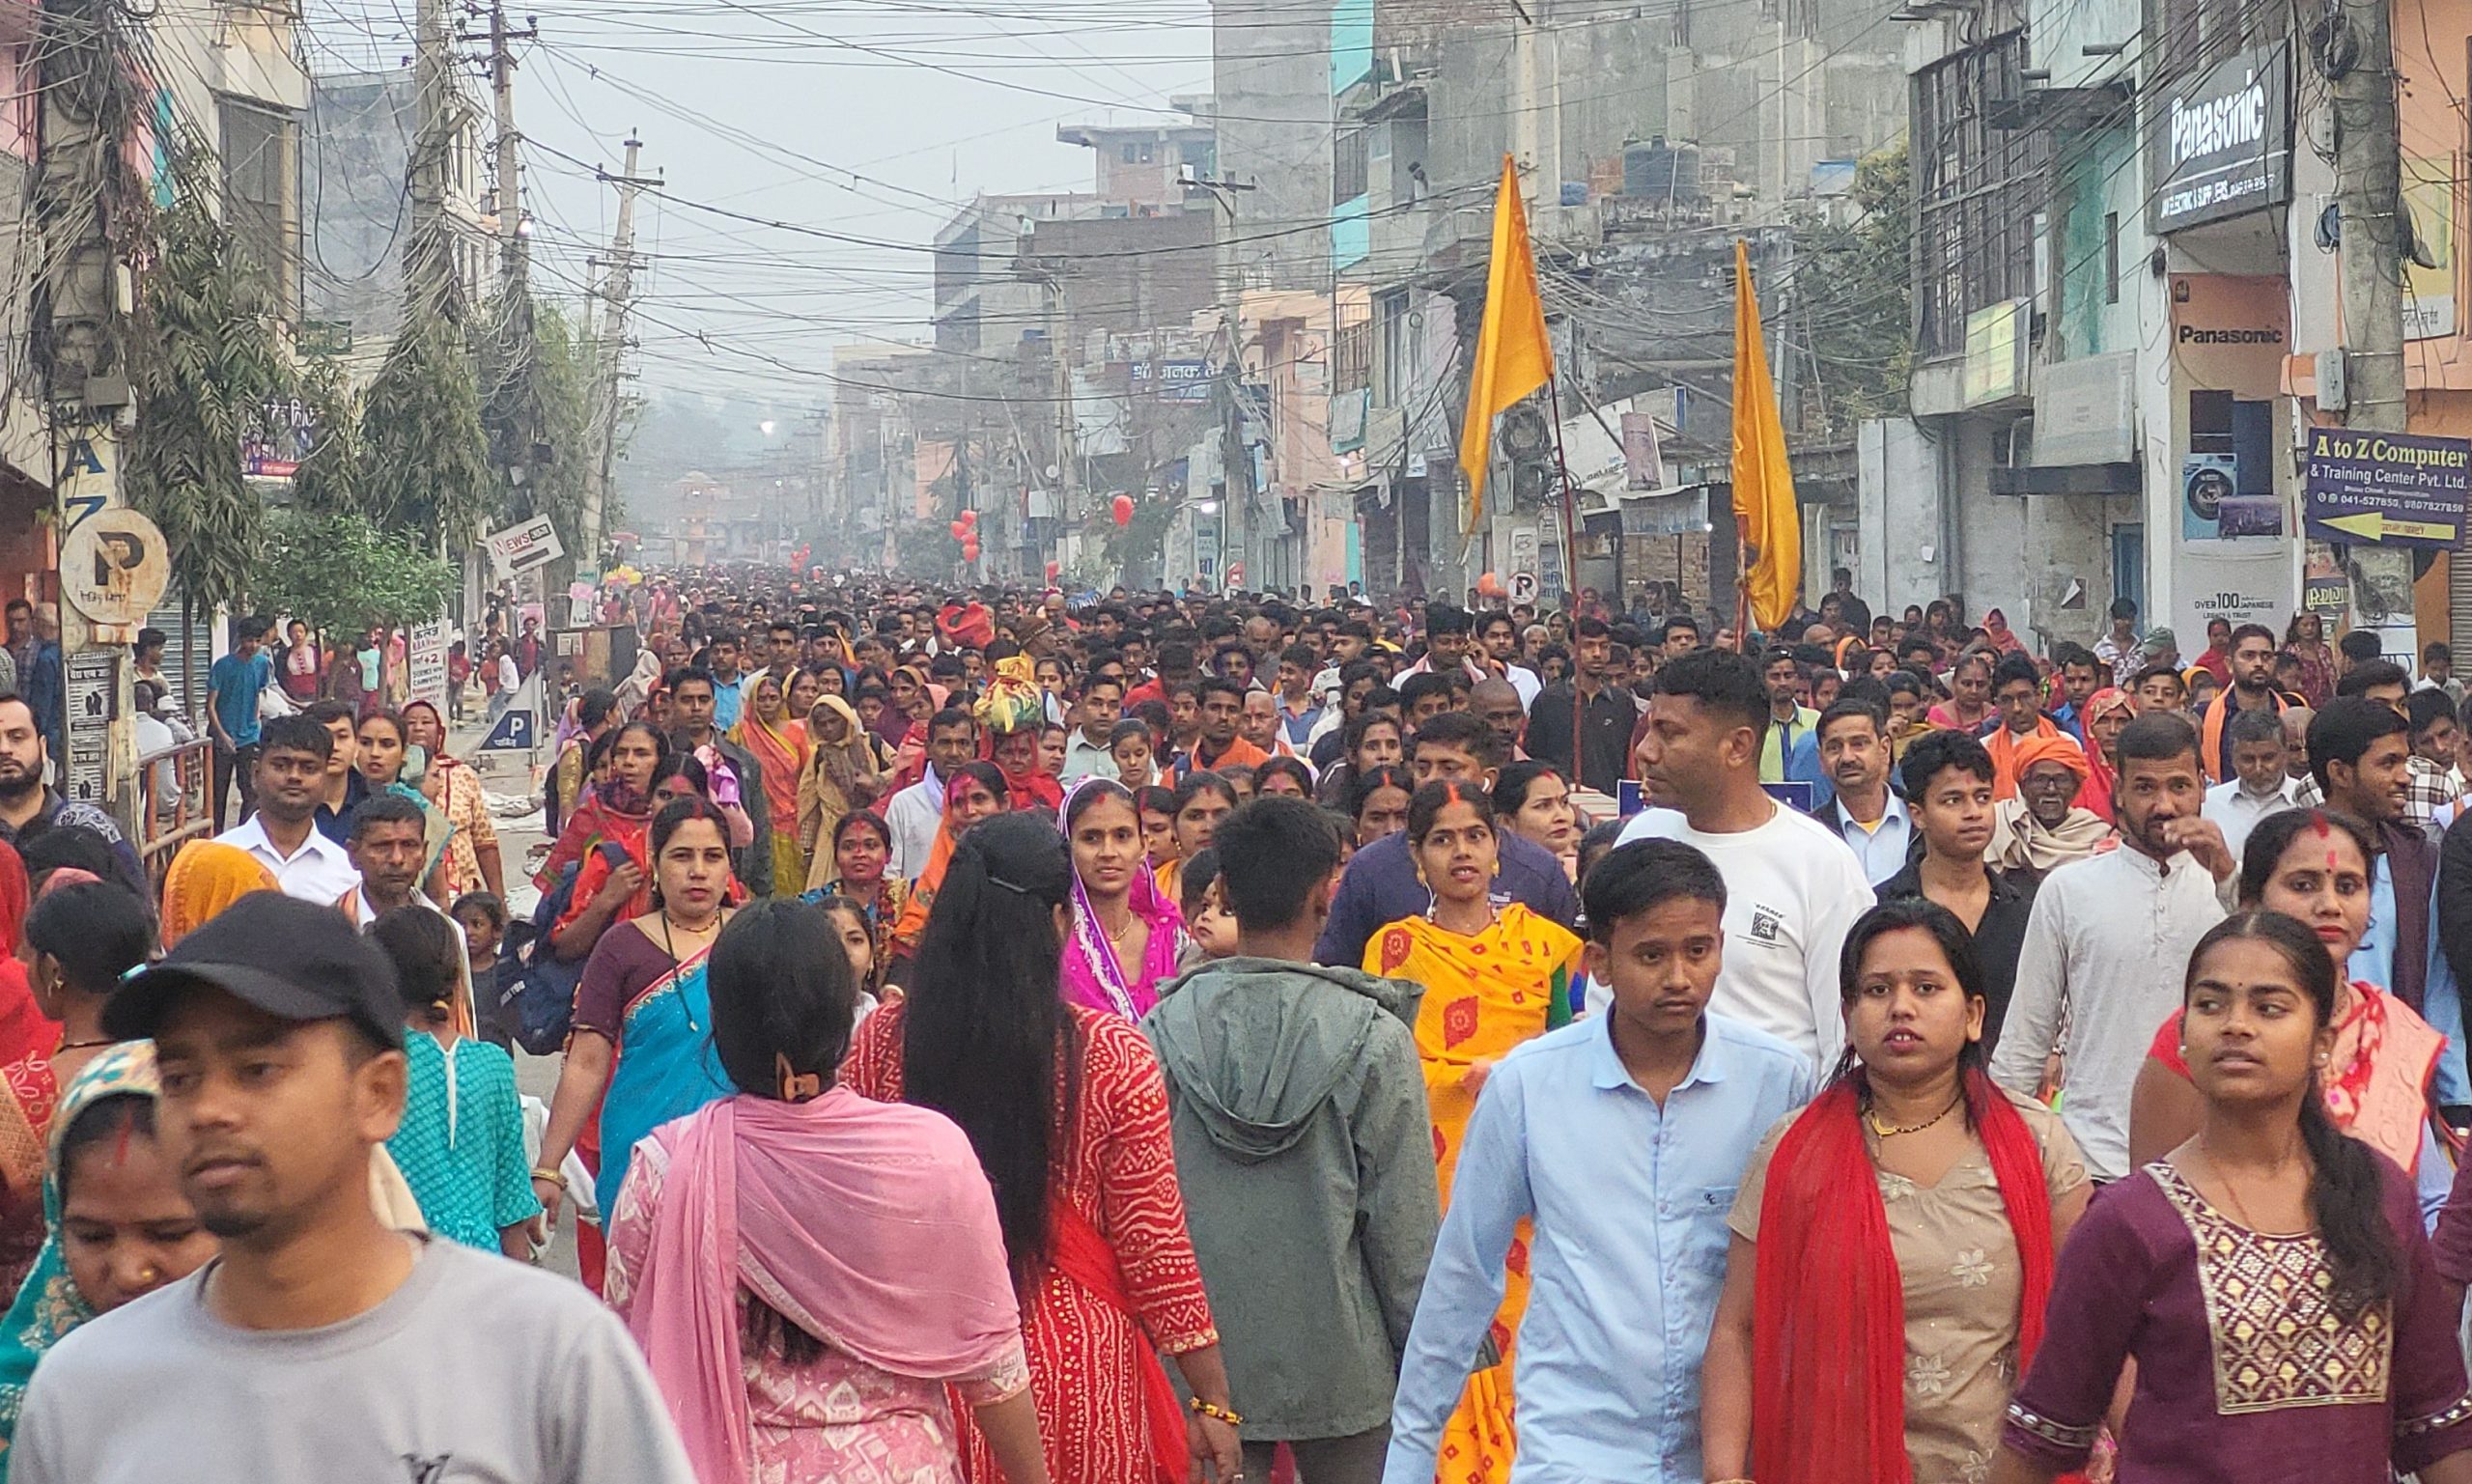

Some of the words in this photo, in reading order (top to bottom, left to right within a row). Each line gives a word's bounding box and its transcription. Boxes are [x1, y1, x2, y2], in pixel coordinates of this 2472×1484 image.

[2172, 69, 2264, 165] Panasonic
[2179, 324, 2283, 344] Panasonic
[2314, 435, 2331, 457] A
[2333, 437, 2352, 459] to
[2355, 438, 2371, 460] Z
[2372, 439, 2468, 470] Computer
[2310, 463, 2318, 477] &
[2322, 464, 2372, 484] Training
[2374, 468, 2415, 486] Center
[2418, 472, 2441, 488] Pvt.
[2445, 474, 2467, 490] Ltd.
[95, 532, 144, 585] P
[1516, 575, 1533, 596] P
[2217, 593, 2239, 609] 100
[510, 716, 524, 738] P
